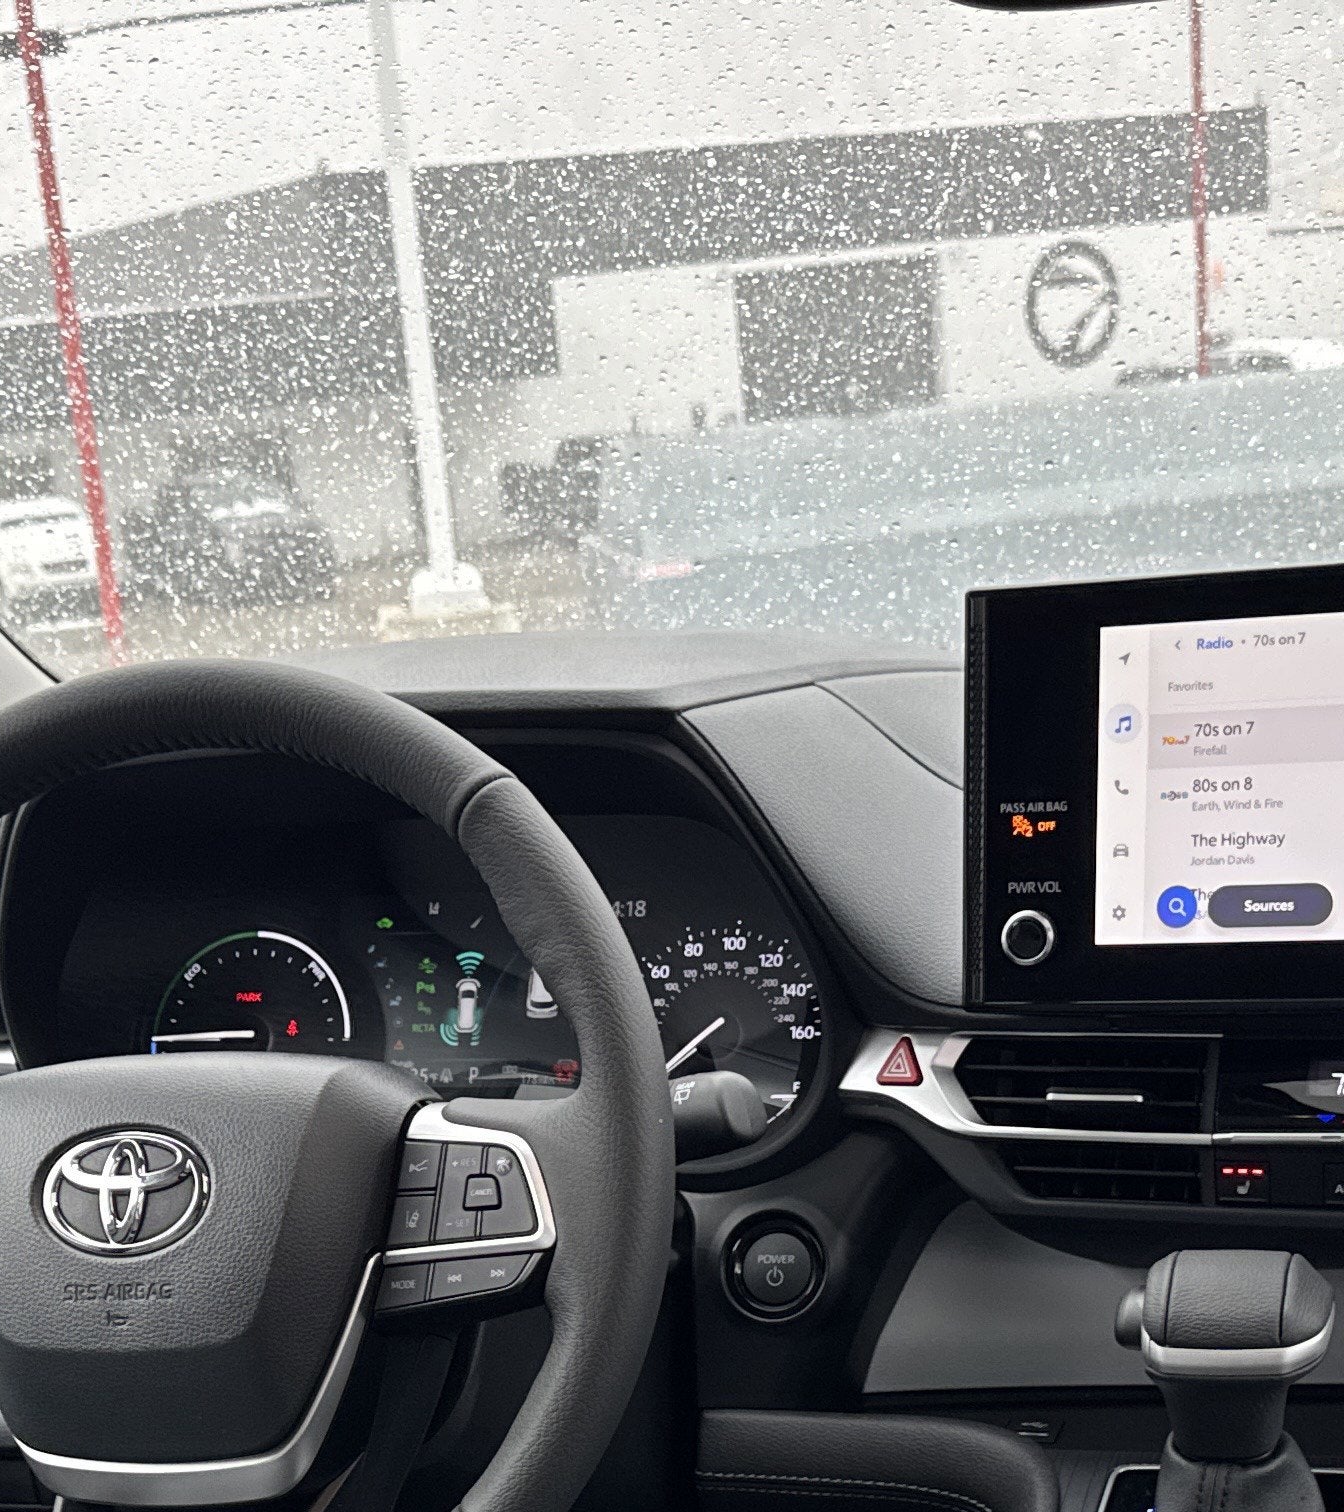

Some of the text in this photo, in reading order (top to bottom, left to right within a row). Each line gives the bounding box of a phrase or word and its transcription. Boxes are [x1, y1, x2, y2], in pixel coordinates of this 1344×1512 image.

[1196, 632, 1307, 650] Radio 70s on 7
[1168, 680, 1214, 692] Favorites
[1194, 721, 1255, 737] 70s on 7
[1193, 745, 1228, 756] Firefall
[1192, 776, 1253, 793] 80s on 8
[1000, 801, 1068, 813] PASS AIR BAG
[1192, 799, 1284, 812] Earth, Wind & Fire
[1037, 820, 1056, 832] OFF
[1191, 832, 1286, 850] The Highway
[1191, 855, 1255, 867] Jordan Davis
[1007, 881, 1061, 894] PWR VOL
[1244, 899, 1295, 913] Sources
[683, 943, 704, 957] 80
[722, 936, 747, 951] 100
[723, 961, 739, 970] 160
[758, 953, 784, 968] 120
[650, 964, 670, 979] 60
[683, 969, 698, 979] 120
[664, 982, 679, 992] 100
[761, 978, 778, 988] 200
[781, 983, 807, 997] 140
[235, 992, 263, 1002] PARK
[777, 1014, 795, 1023] 240
[789, 1026, 815, 1040] 160
[469, 1066, 480, 1084] P
[792, 1081, 801, 1092] F
[757, 1253, 796, 1265] POWER
[391, 1279, 416, 1290] MODE
[63, 1282, 173, 1301] SRS AIRBAG
